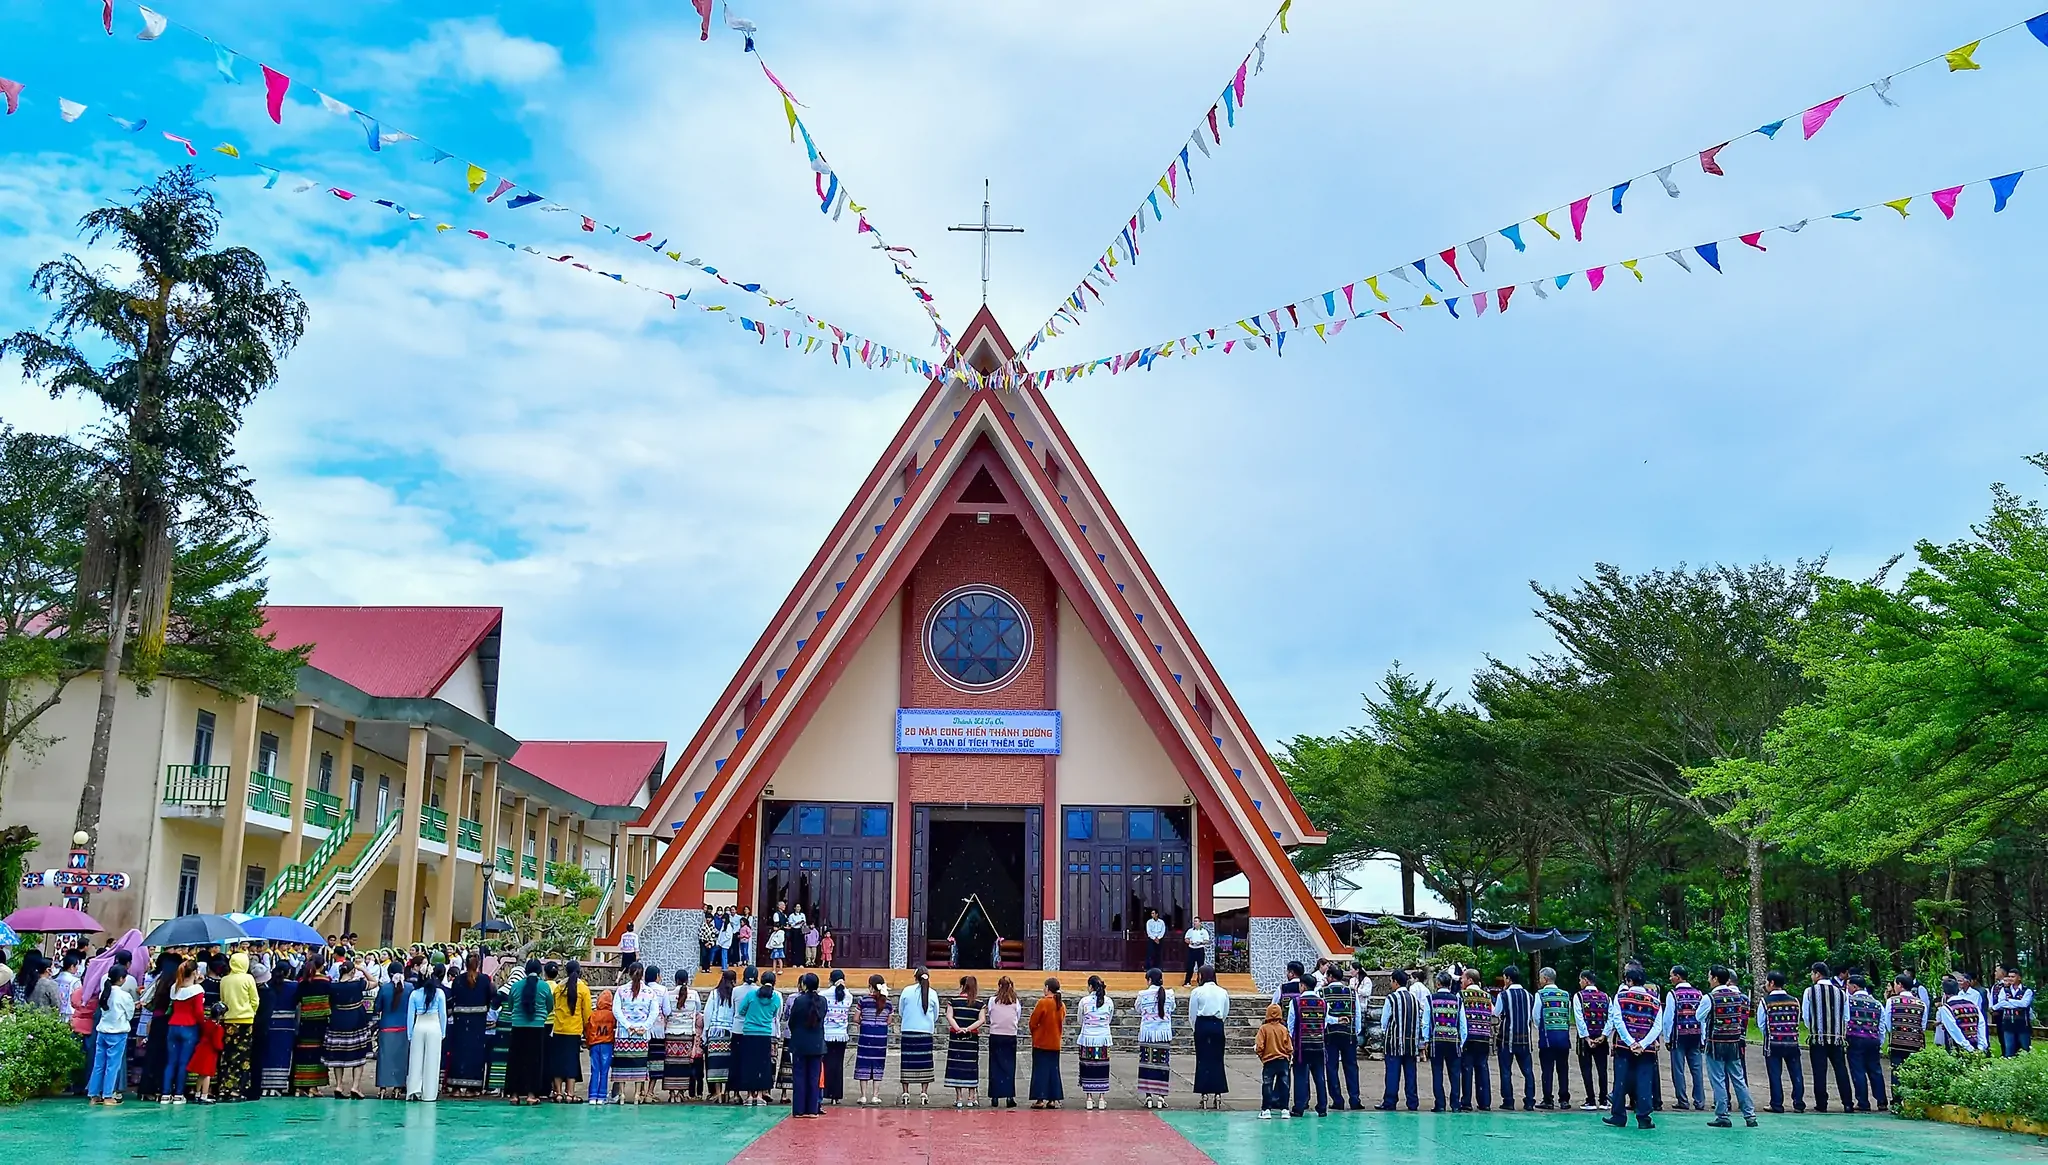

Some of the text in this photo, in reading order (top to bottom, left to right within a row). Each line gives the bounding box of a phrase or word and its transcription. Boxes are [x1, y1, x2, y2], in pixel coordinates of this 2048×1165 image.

[904, 725, 1053, 738] 20 NĂM CUNG HIẾN THÁNH ĐƯỜNG
[922, 737, 1035, 748] VÀ BAN BÍ TÍCH THÊM SỨC
